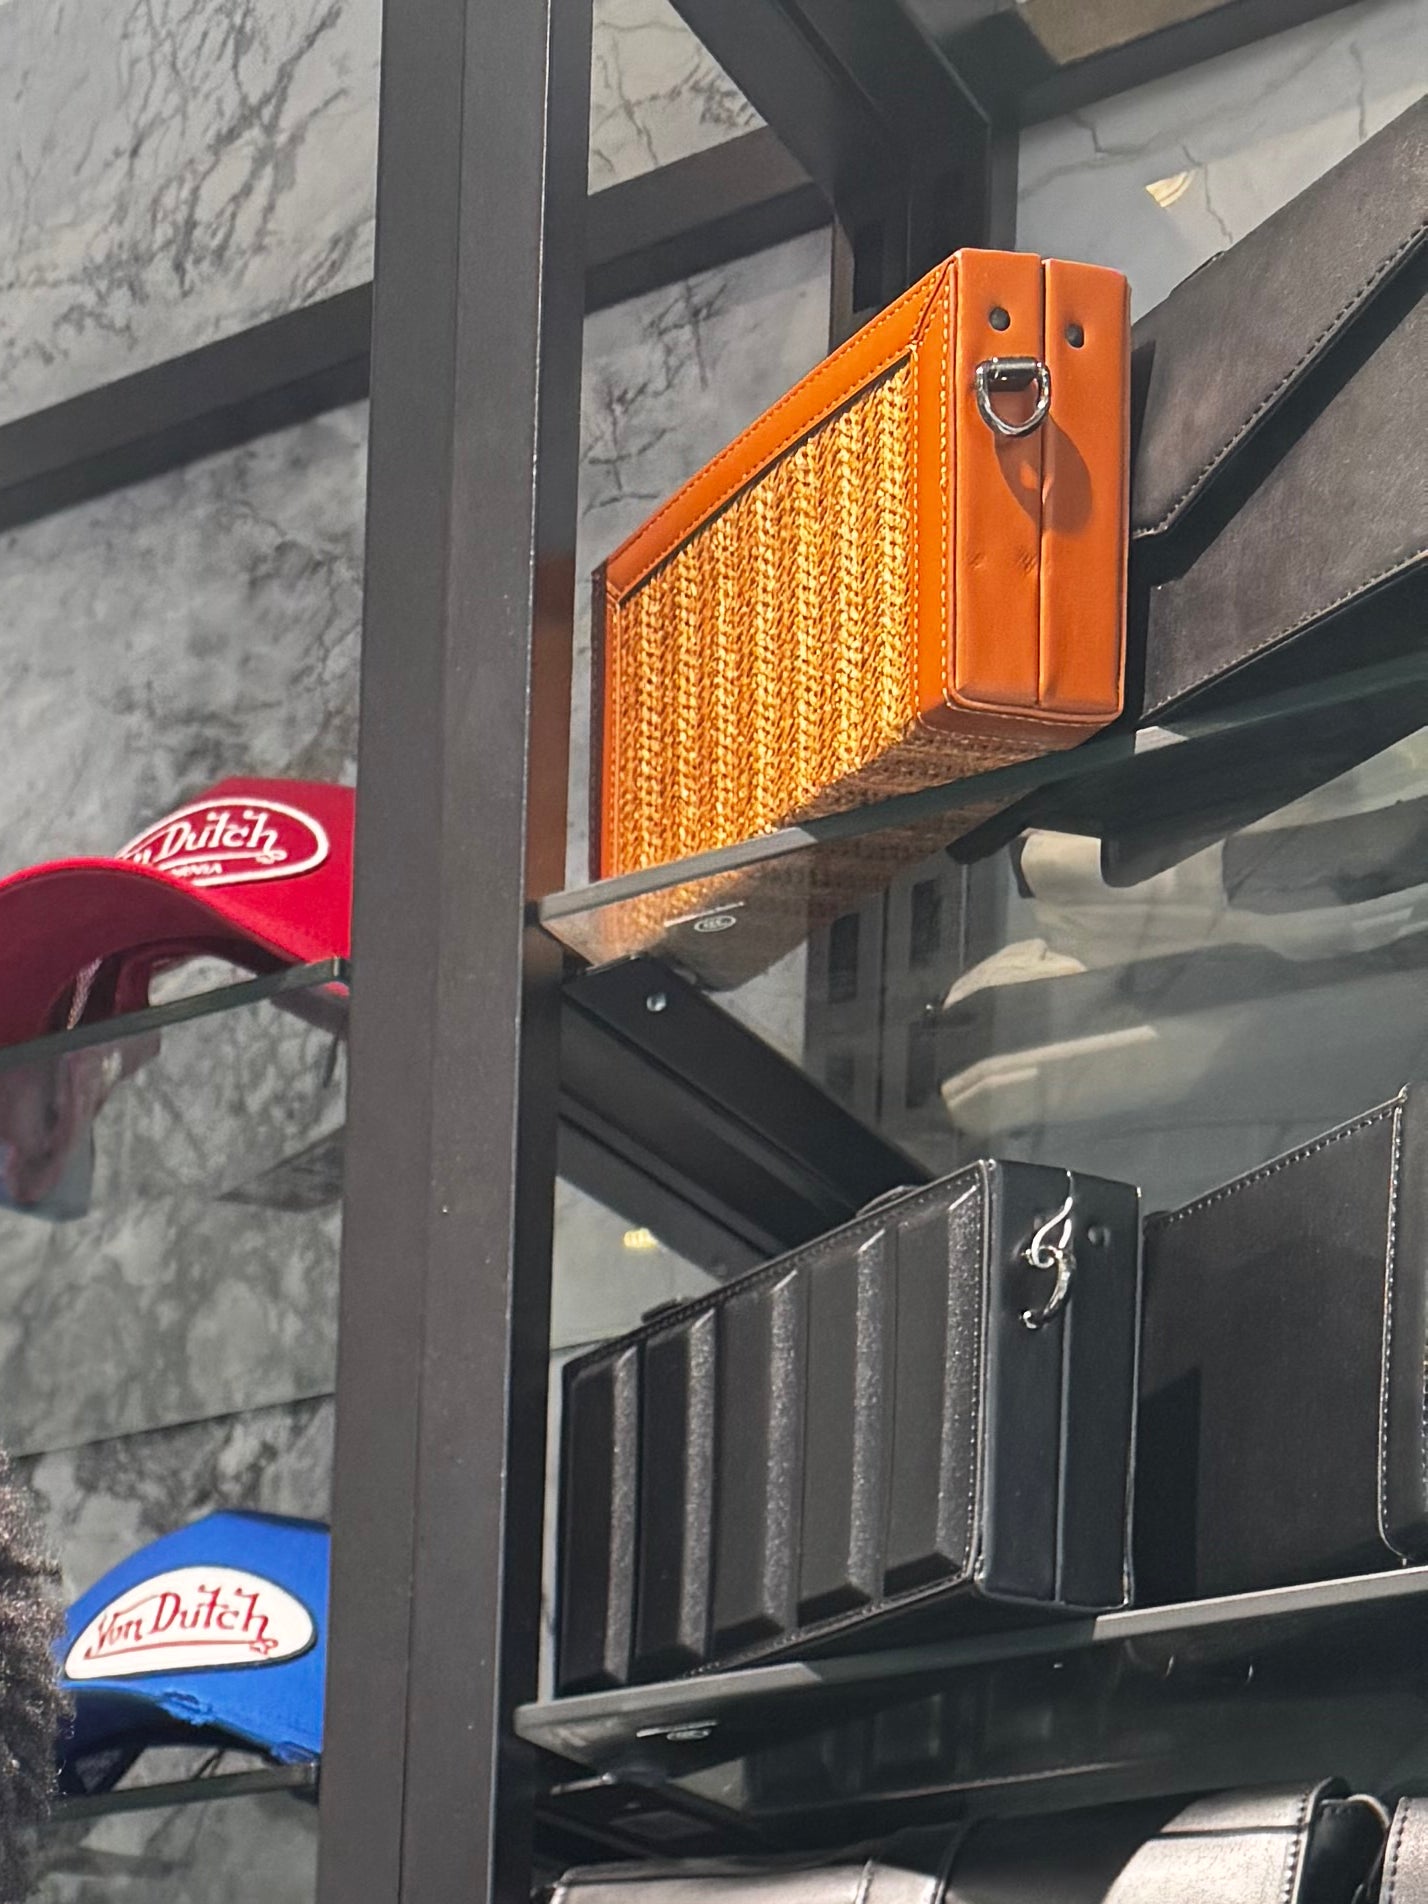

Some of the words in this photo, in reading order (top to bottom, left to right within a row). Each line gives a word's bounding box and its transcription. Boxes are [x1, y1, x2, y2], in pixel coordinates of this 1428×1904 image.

[152, 810, 282, 864] Dutch
[91, 1597, 148, 1655] Von
[148, 1585, 272, 1648] Dutch
